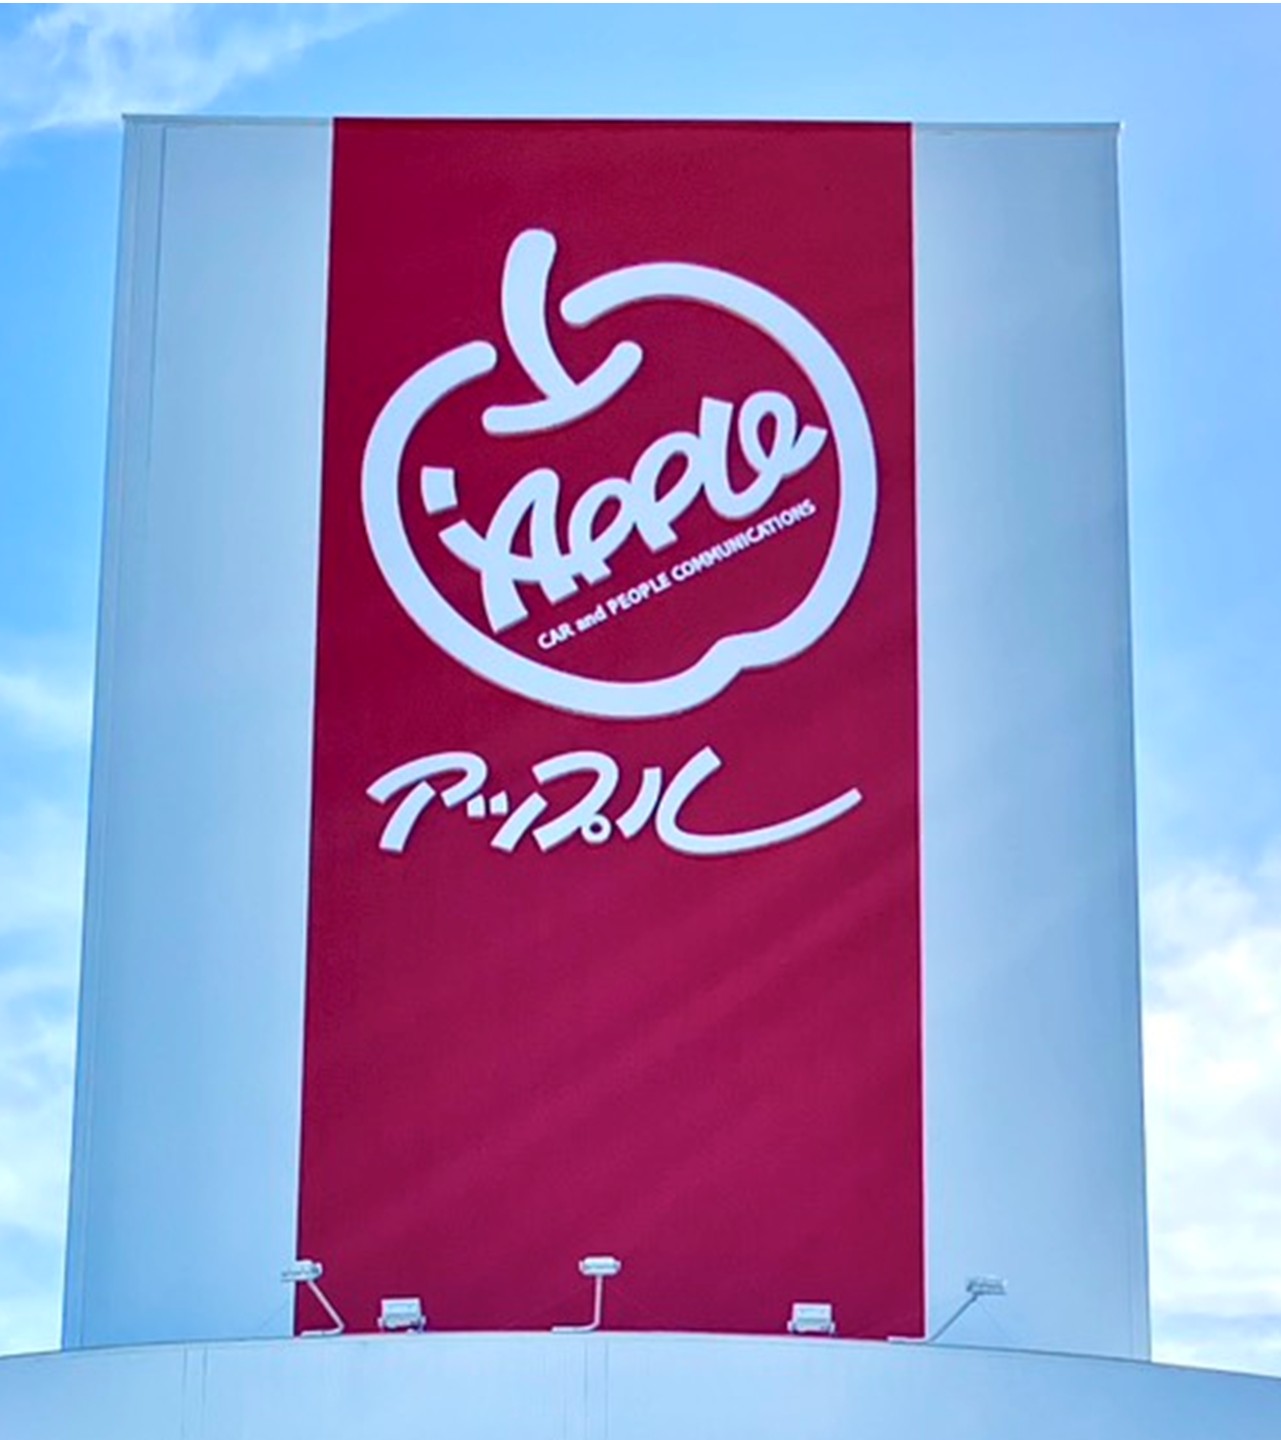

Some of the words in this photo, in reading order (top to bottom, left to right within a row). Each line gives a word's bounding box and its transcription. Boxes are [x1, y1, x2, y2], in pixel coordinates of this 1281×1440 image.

[537, 623, 575, 650] CAR
[576, 605, 607, 630] and
[606, 572, 671, 616] PEOPLE
[671, 498, 817, 582] COMMUNICATIONS
[366, 747, 862, 855] アップル
